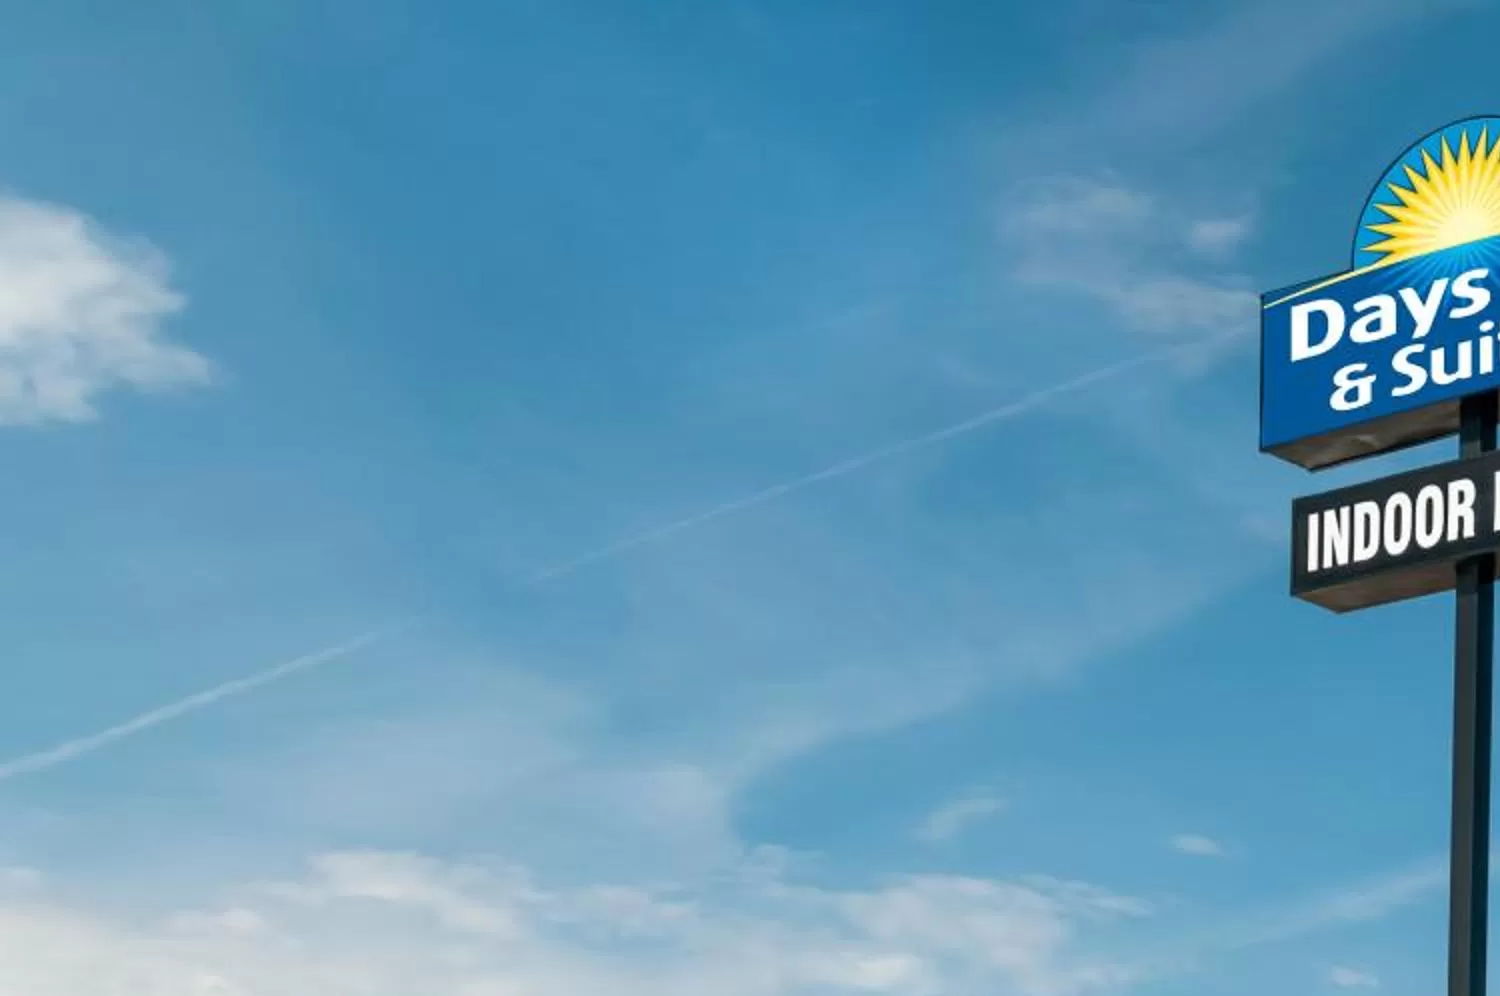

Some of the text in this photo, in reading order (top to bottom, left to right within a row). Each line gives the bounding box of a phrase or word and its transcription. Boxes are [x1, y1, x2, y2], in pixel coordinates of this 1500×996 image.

[1291, 268, 1491, 363] Days
[1330, 363, 1378, 412] &
[1307, 478, 1477, 573] INDOOR
